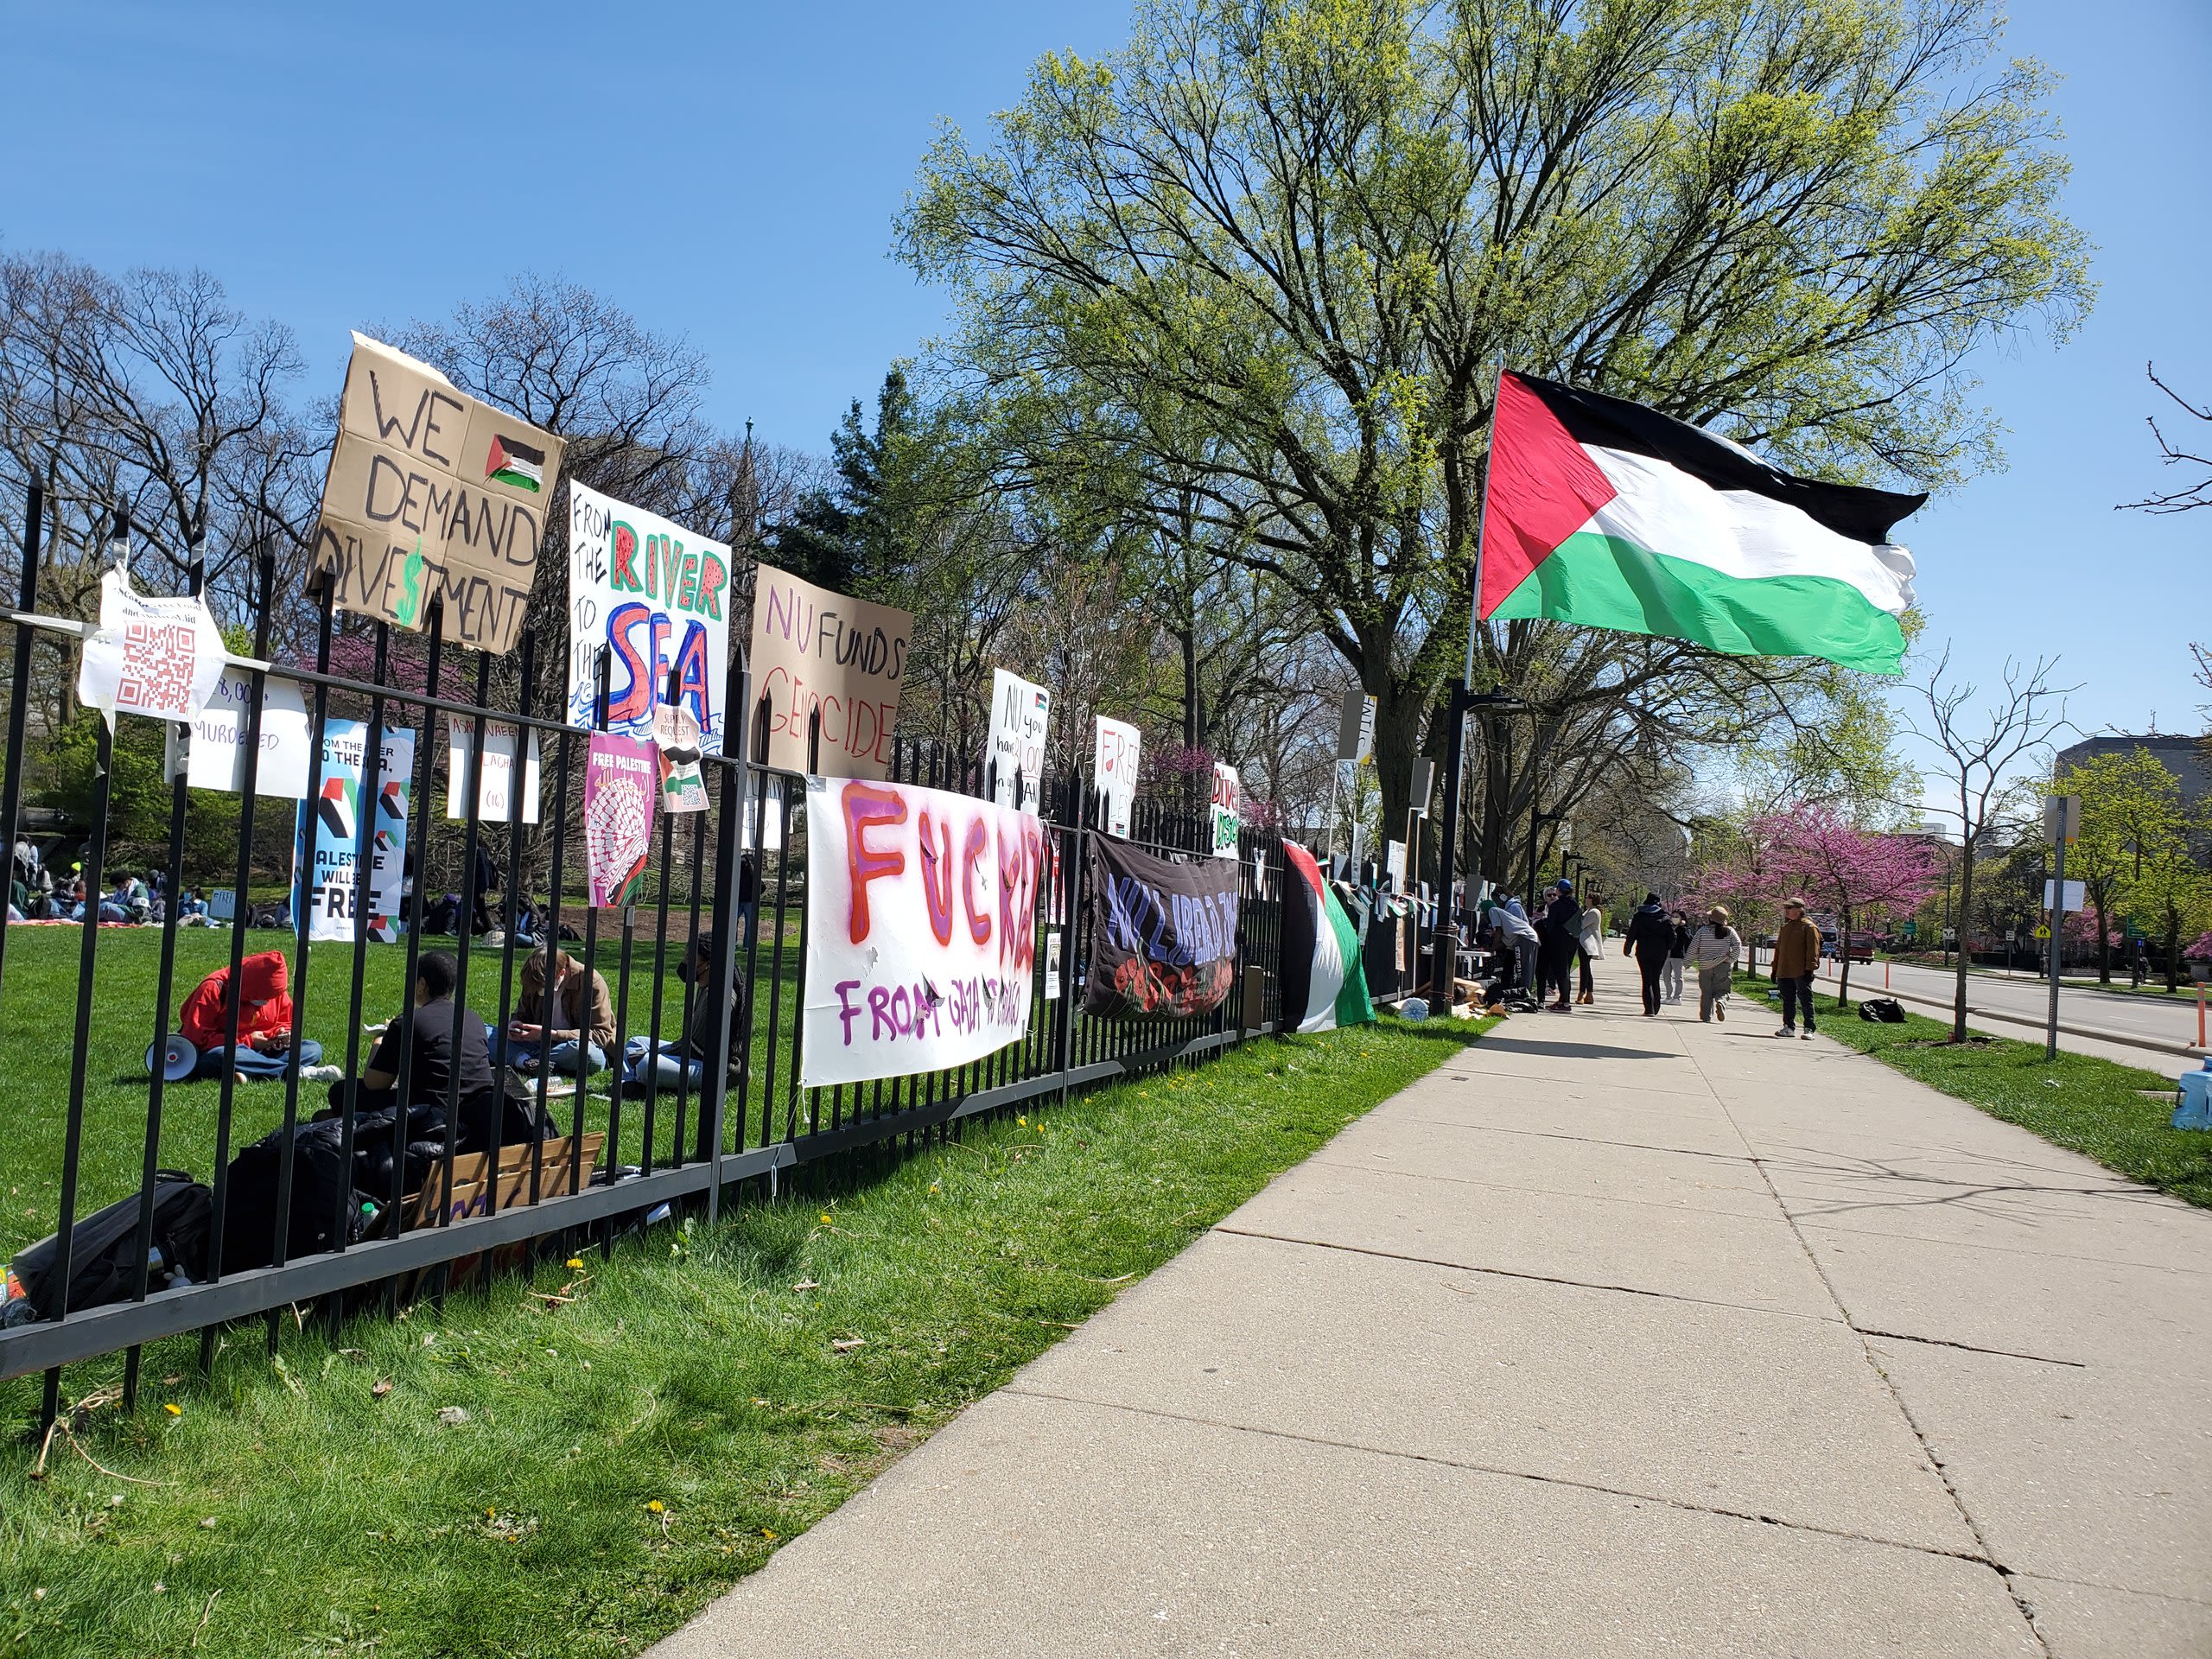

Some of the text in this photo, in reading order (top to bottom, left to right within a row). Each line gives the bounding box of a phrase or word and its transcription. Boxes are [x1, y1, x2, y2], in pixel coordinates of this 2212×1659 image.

[369, 370, 464, 467] WE
[365, 454, 538, 567] DEMAND
[573, 492, 612, 543] FROM
[574, 541, 607, 585] THE
[609, 519, 728, 622] RIVER
[574, 595, 597, 632] TO
[766, 584, 906, 680] NU FUNDS
[573, 639, 608, 683] THE
[594, 601, 711, 735] SEA
[189, 720, 280, 750] MURDEED
[760, 666, 896, 765] GENOCIDE
[1024, 715, 1043, 739] you
[322, 739, 340, 749] OM
[342, 741, 363, 752] THE
[334, 751, 360, 766] THE
[592, 752, 652, 775] FREE PALESTINE
[486, 790, 505, 809] (16)
[316, 849, 385, 871] ALESTIE
[321, 869, 351, 885] WILL
[841, 780, 1021, 969] FUCK
[311, 886, 382, 921] FREE
[835, 979, 942, 1046] FROM
